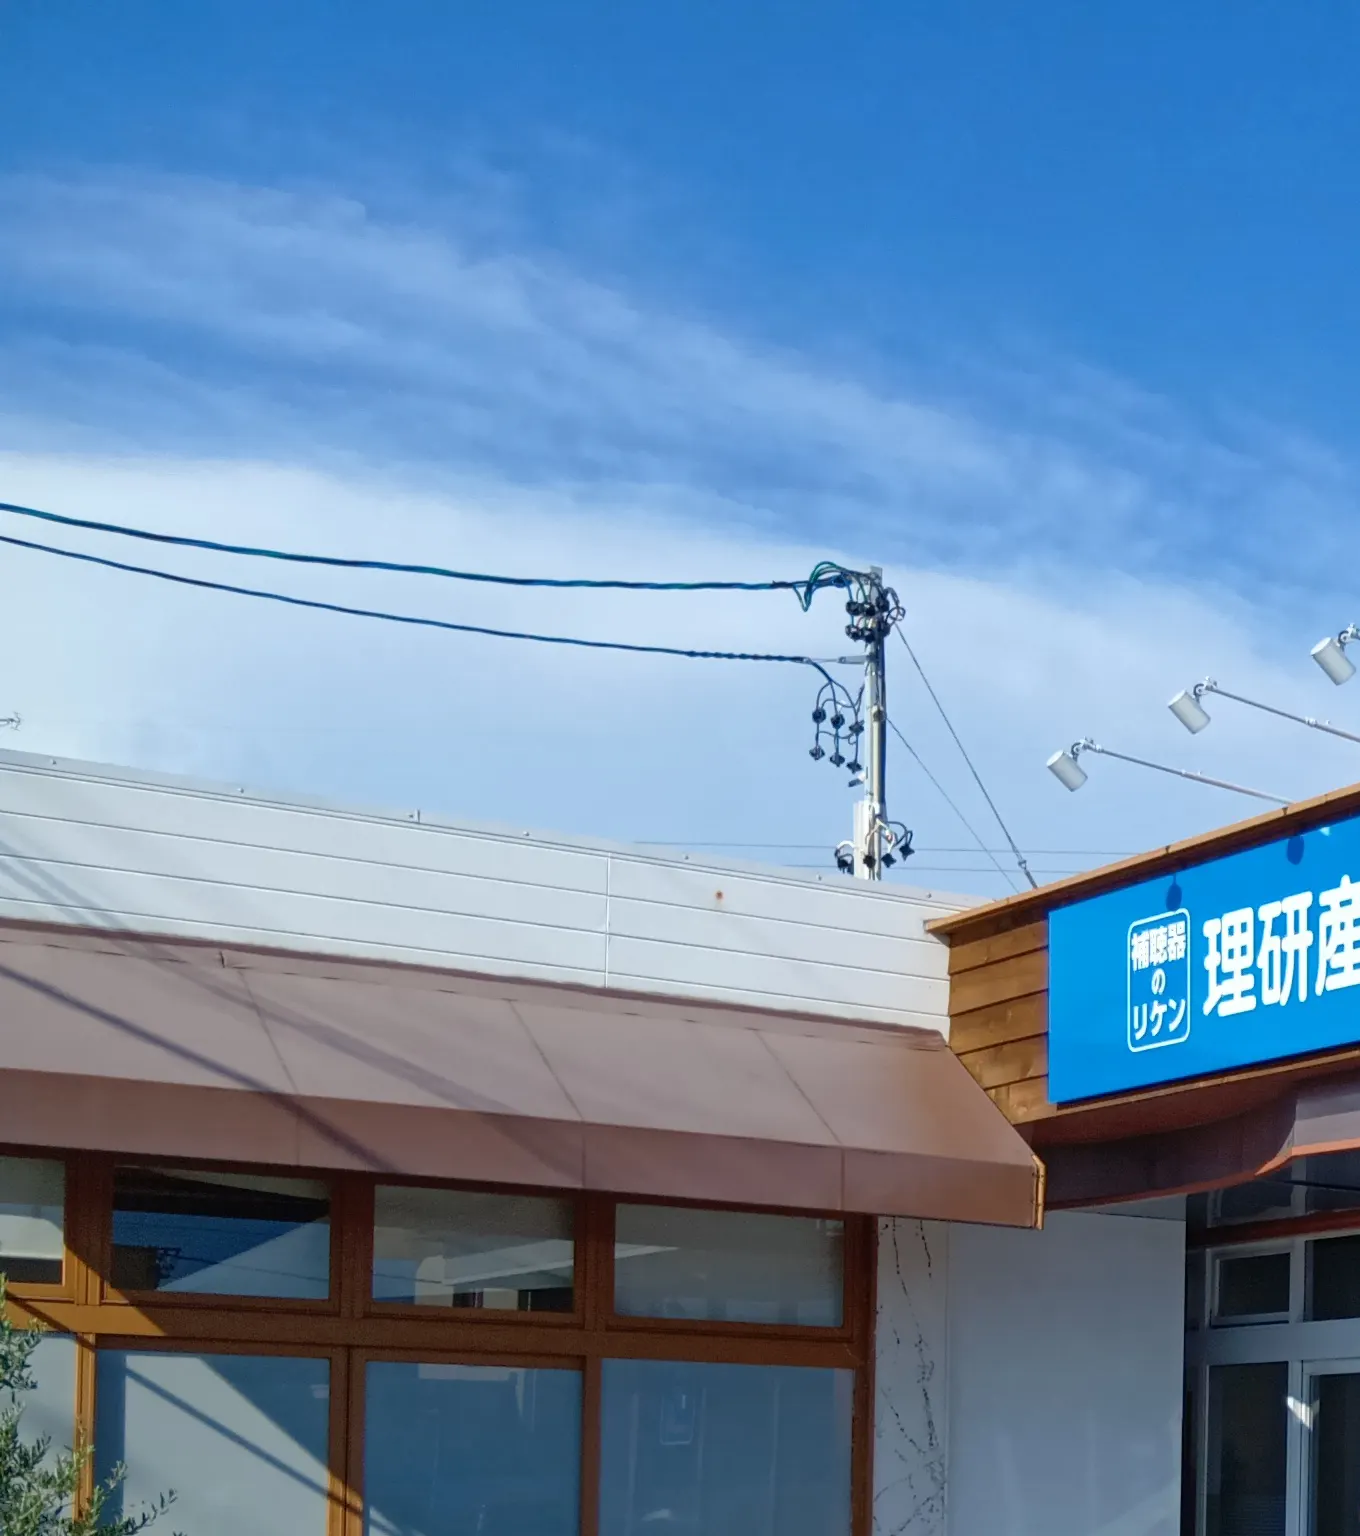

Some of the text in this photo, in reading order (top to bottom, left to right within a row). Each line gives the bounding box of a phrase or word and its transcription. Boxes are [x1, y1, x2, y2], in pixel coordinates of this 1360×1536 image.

[1131, 920, 1186, 972] 補聴器
[1151, 968, 1166, 994] の
[1133, 999, 1185, 1040] リケン
